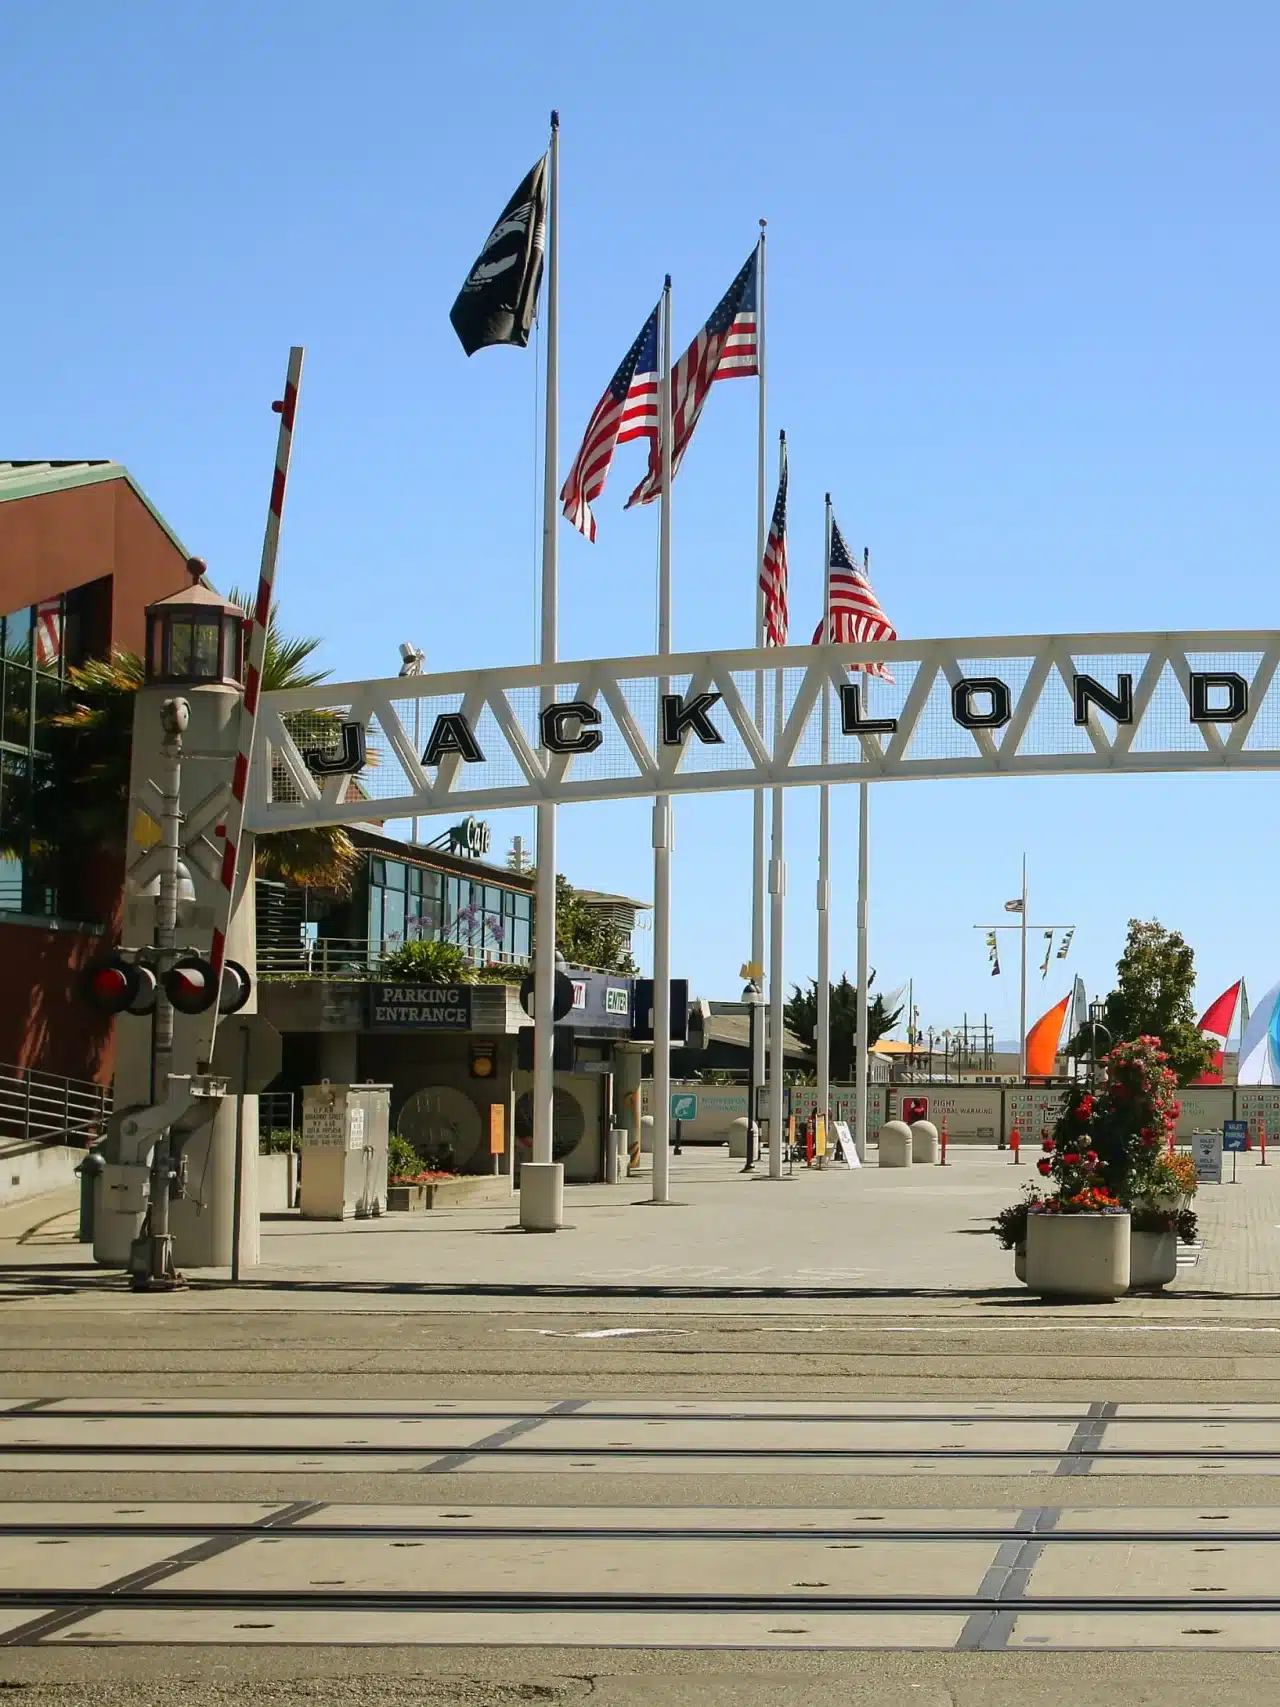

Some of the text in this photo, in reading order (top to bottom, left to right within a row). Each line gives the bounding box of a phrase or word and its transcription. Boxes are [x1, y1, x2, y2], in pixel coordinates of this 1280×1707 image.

[305, 692, 725, 778] JACK
[383, 988, 460, 1004] PARKING
[608, 991, 627, 1012] ENTER
[375, 1006, 467, 1023] ENTRANCE
[932, 1099, 956, 1107] FIGHT
[932, 1107, 993, 1115] GLOBAL WARMING
